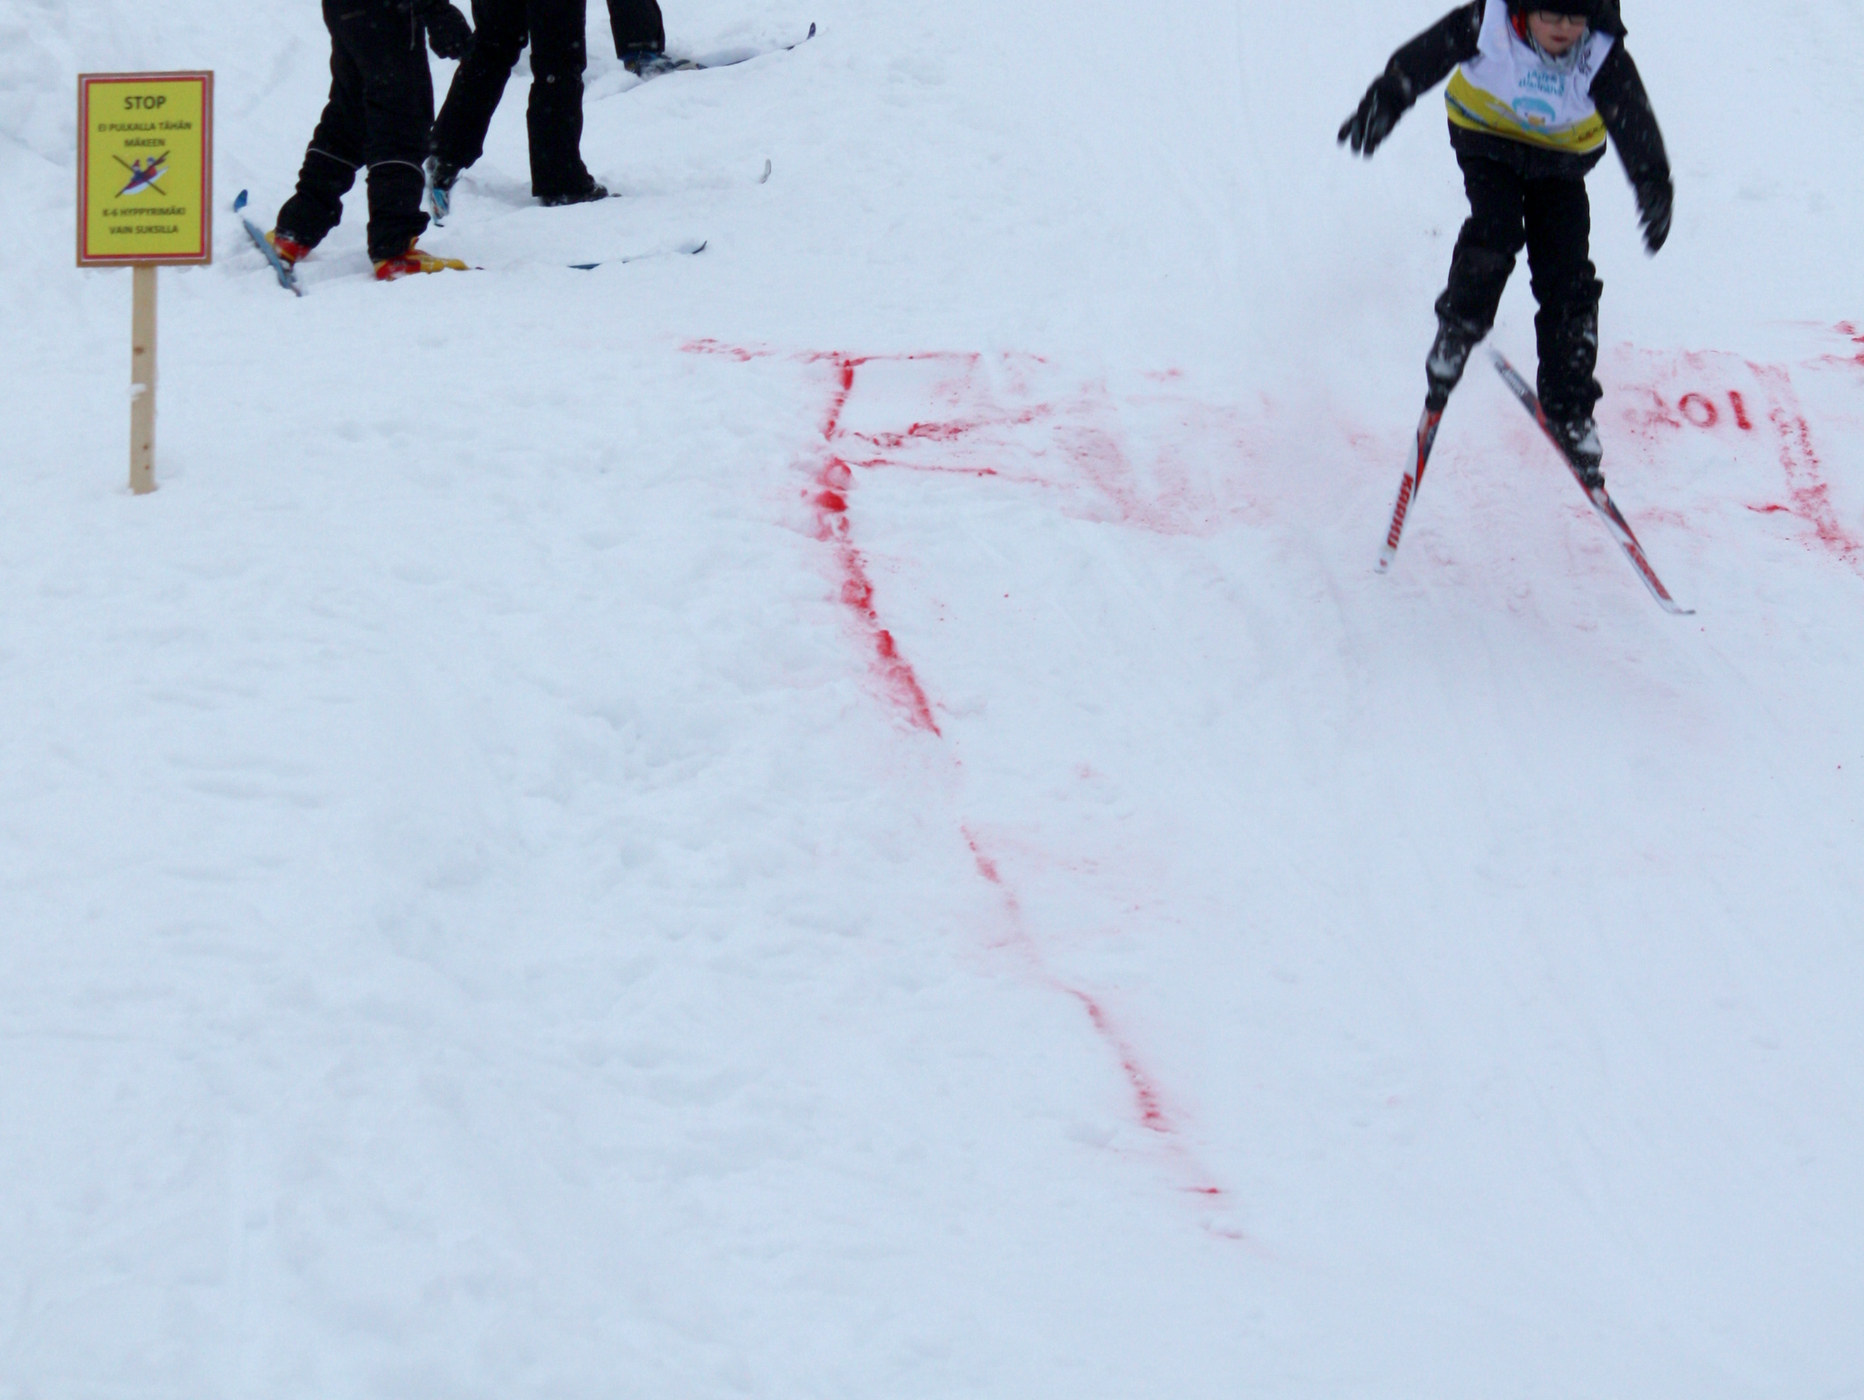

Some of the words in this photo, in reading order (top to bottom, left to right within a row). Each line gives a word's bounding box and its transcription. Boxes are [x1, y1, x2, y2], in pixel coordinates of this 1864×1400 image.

[124, 95, 166, 110] STOP
[98, 123, 107, 132] EI
[109, 122, 156, 132] PULKALLA
[159, 120, 192, 131] TÄHÄN
[124, 137, 166, 147] MÄKEEN
[120, 206, 186, 216] HYPPYRIMÄKI
[109, 225, 133, 235] VAIN
[136, 224, 179, 234] SUKSILLA
